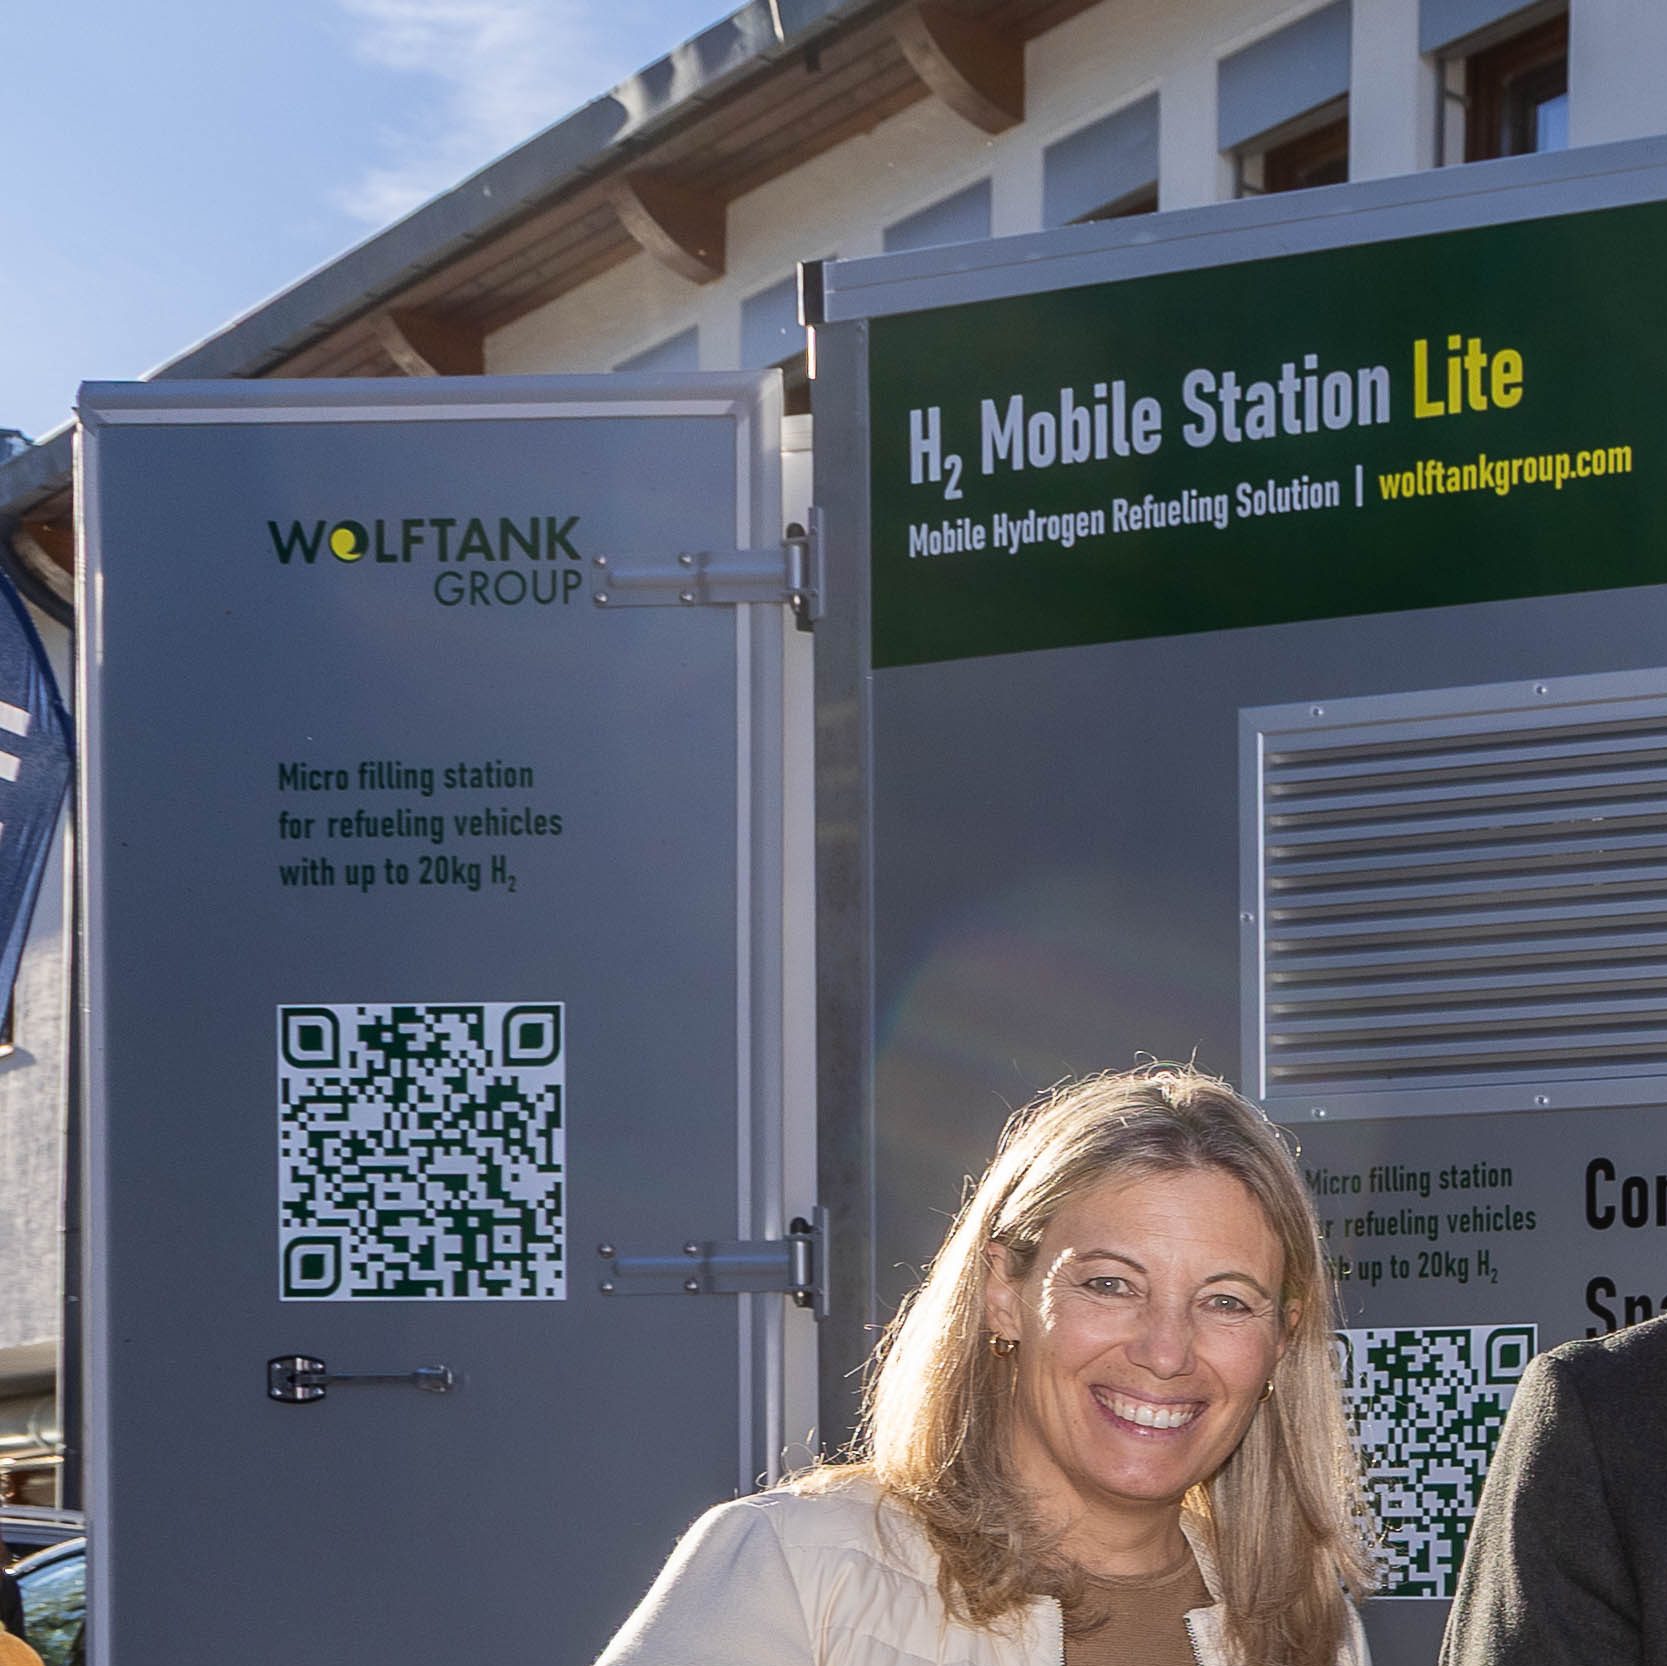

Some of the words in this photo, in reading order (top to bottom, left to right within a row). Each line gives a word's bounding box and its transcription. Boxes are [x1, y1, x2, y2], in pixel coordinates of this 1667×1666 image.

[981, 381, 1162, 475] Mobile
[1182, 354, 1390, 447] Station
[1413, 335, 1524, 420] Lite
[909, 508, 985, 557] Mobile
[993, 503, 1104, 554] Hydrogen
[1112, 489, 1228, 533] Refueling
[1236, 475, 1339, 518] Solution
[1378, 446, 1632, 499] wolftankgroup.com
[267, 515, 581, 564] WOLFTANK
[434, 569, 582, 606] GROUP
[279, 762, 349, 791] Micro
[358, 761, 434, 797] filling
[444, 760, 533, 788] station
[280, 811, 315, 839] for
[328, 808, 444, 844] refueling
[455, 807, 563, 836] vehicles
[280, 857, 334, 886] with
[345, 864, 374, 892] up
[384, 858, 407, 885] to
[419, 855, 481, 891] 20kg
[1305, 1169, 1361, 1196] Micro
[1369, 1165, 1431, 1197] filling
[1439, 1162, 1512, 1190] station
[1344, 1208, 1438, 1241] refueling
[1447, 1204, 1536, 1232] vehicles
[1358, 1259, 1382, 1286] up
[1390, 1254, 1409, 1278] to
[1418, 1251, 1468, 1283] 20kg
